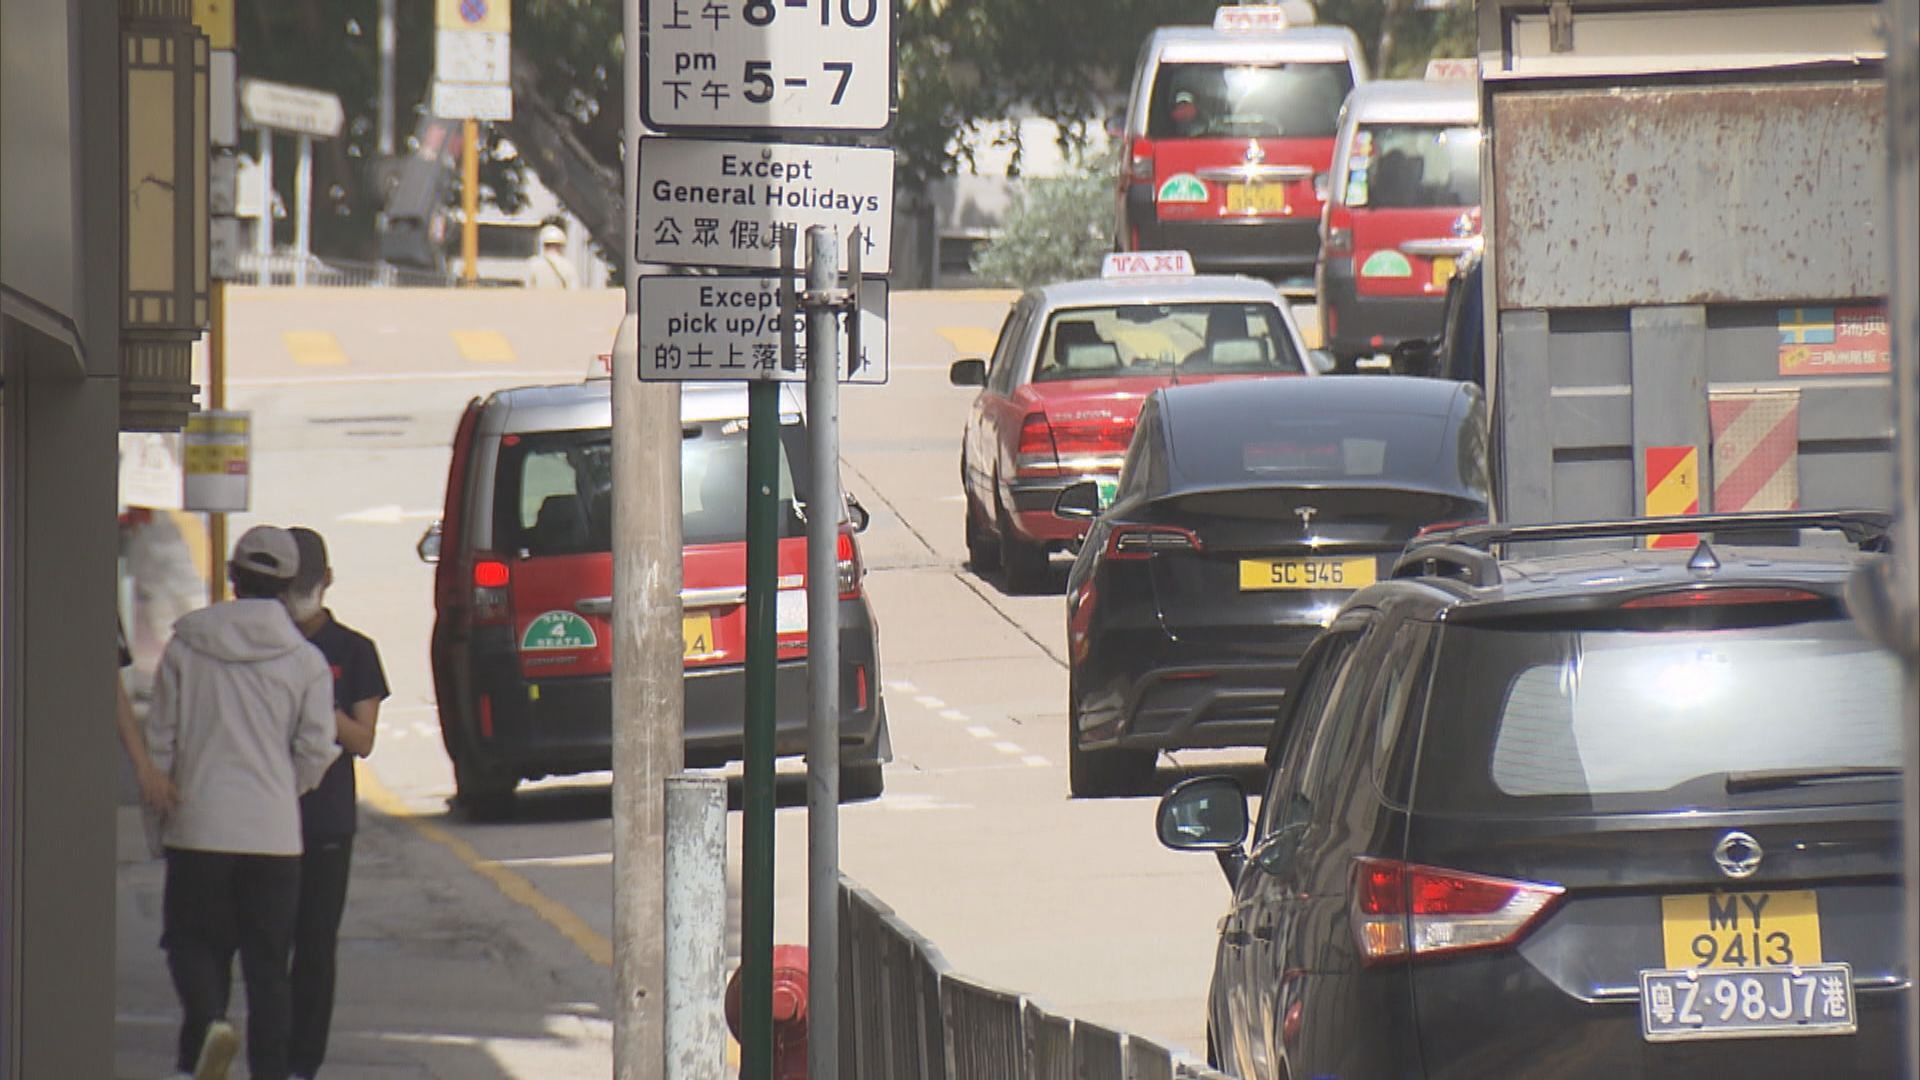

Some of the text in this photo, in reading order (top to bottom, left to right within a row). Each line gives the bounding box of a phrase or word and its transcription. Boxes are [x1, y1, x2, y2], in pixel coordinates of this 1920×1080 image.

[675, 52, 717, 75] pm
[662, 81, 731, 110] 下午
[722, 155, 813, 182] Except
[653, 180, 879, 215] General Holidays
[1111, 255, 1184, 273] TAXI
[700, 286, 782, 311] Except
[668, 312, 717, 337] pick
[1271, 562, 1343, 584] SC 946
[551, 622, 567, 638] 4
[1707, 893, 1769, 932] MY
[1691, 931, 1794, 968] 9413
